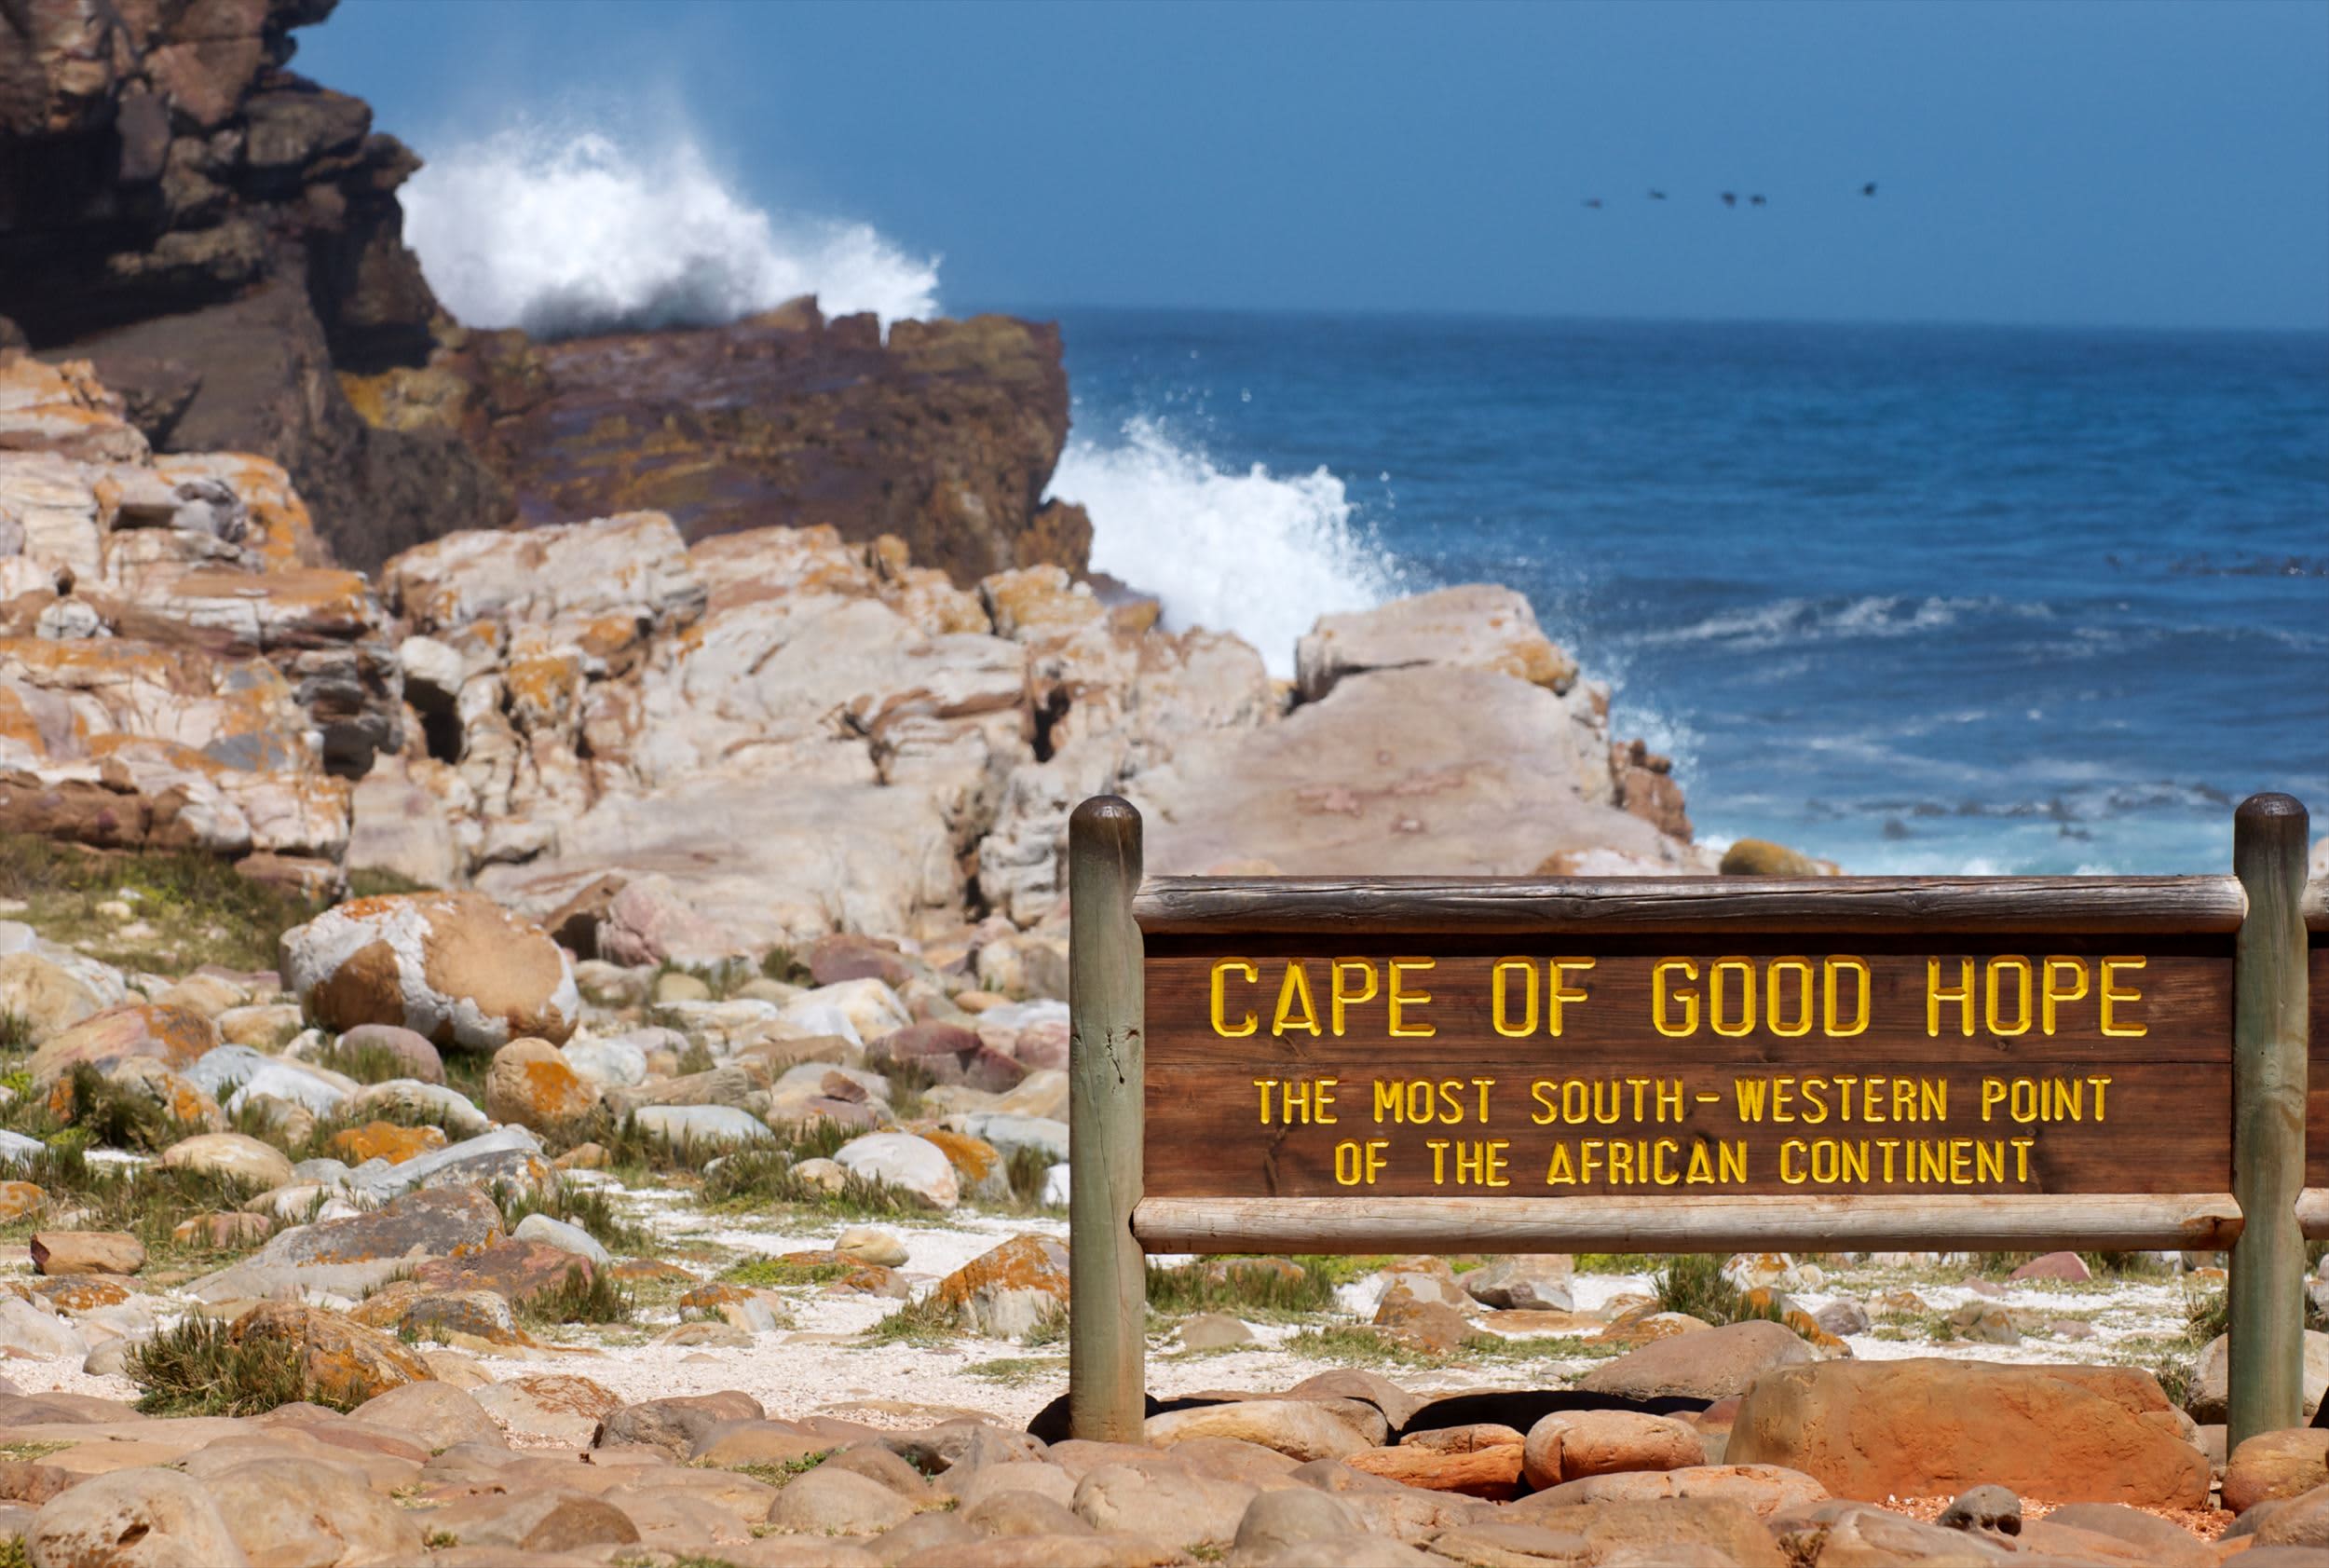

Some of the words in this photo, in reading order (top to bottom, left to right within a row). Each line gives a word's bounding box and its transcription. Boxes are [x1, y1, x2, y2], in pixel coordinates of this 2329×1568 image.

[1209, 956, 1437, 1038] CAPE
[1492, 956, 1596, 1038] OF
[1652, 955, 1872, 1038] GOOD
[1927, 955, 2147, 1037] HOPE
[1253, 1076, 1339, 1125] THE
[1373, 1077, 1496, 1125] MOST
[1982, 1075, 2112, 1124] POINT
[1334, 1139, 1389, 1186] OF
[1426, 1139, 1510, 1187] THE
[1546, 1138, 1748, 1186] AFRICAN
[1779, 1138, 2035, 1185] CONTINENT
